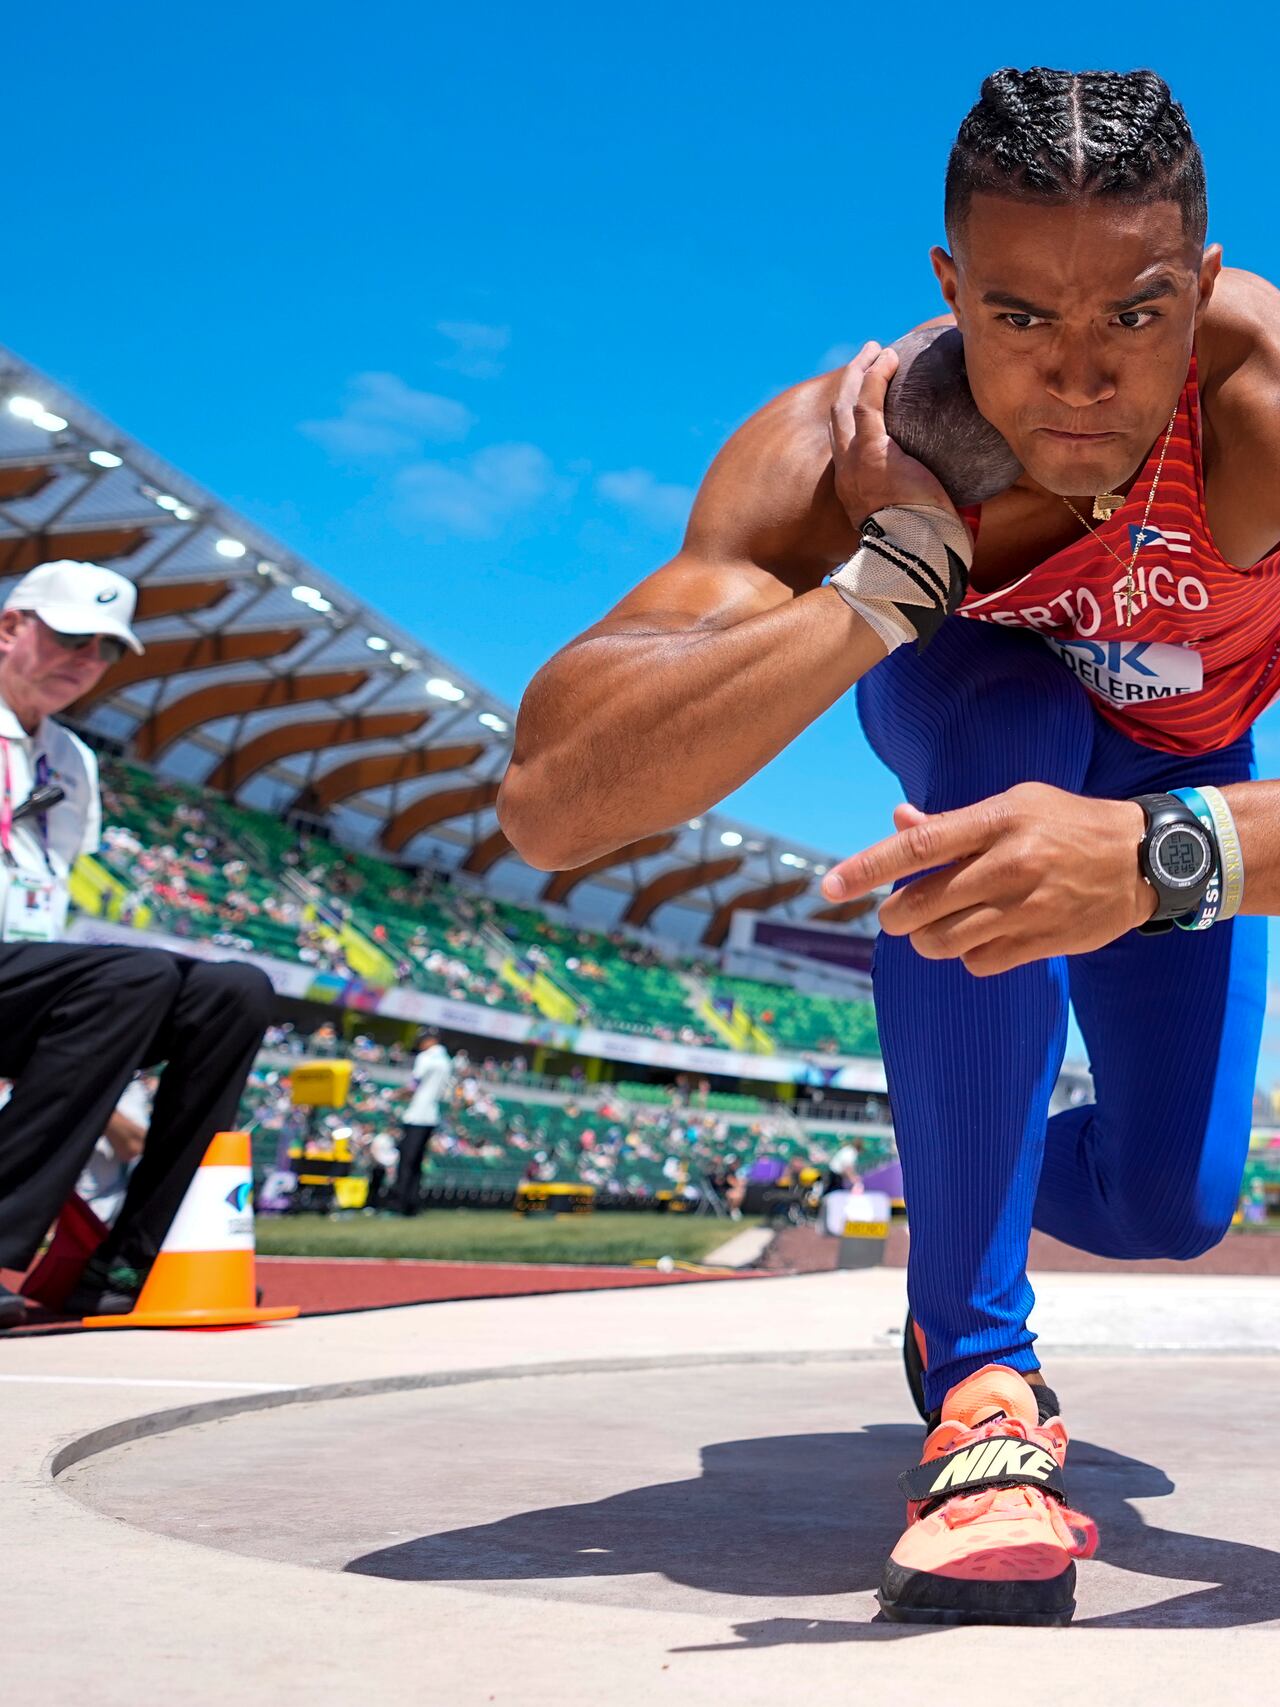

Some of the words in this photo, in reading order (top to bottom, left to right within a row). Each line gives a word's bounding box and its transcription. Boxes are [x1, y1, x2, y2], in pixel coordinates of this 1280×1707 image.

[1112, 566, 1209, 627] RICO
[1220, 831, 1240, 870] TRACK
[929, 1438, 1059, 1493] NIKE
